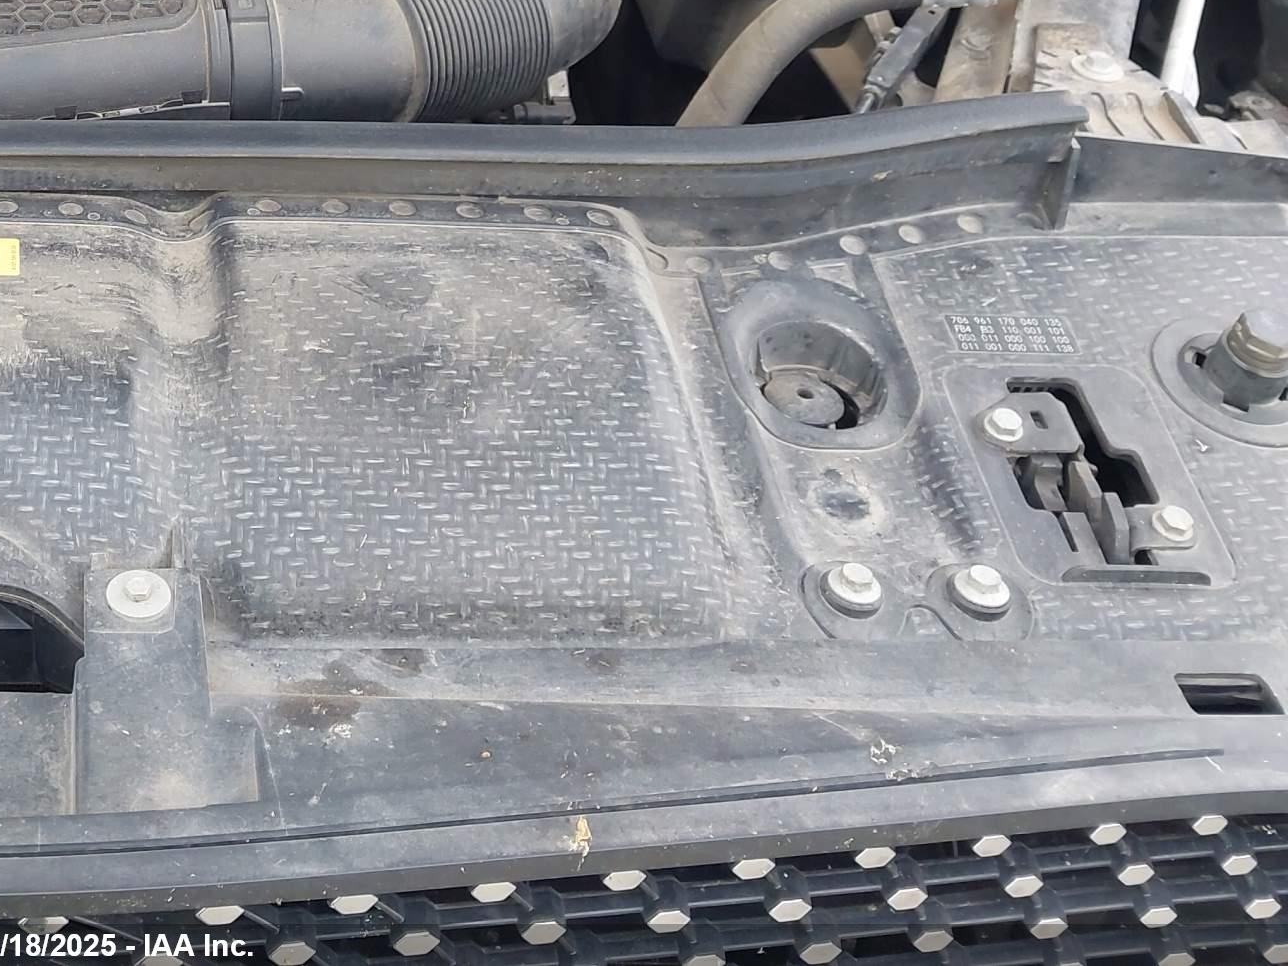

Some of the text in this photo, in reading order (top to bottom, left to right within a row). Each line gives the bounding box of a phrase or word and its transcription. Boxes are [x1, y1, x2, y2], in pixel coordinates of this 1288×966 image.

[998, 317, 1015, 326] 170
[1002, 326, 1019, 334] 110
[1048, 327, 1065, 335] 101
[981, 334, 999, 342] 011
[1028, 336, 1047, 344] 100
[1052, 336, 1070, 344] 100
[961, 343, 979, 351] 011
[1032, 344, 1050, 352] 111
